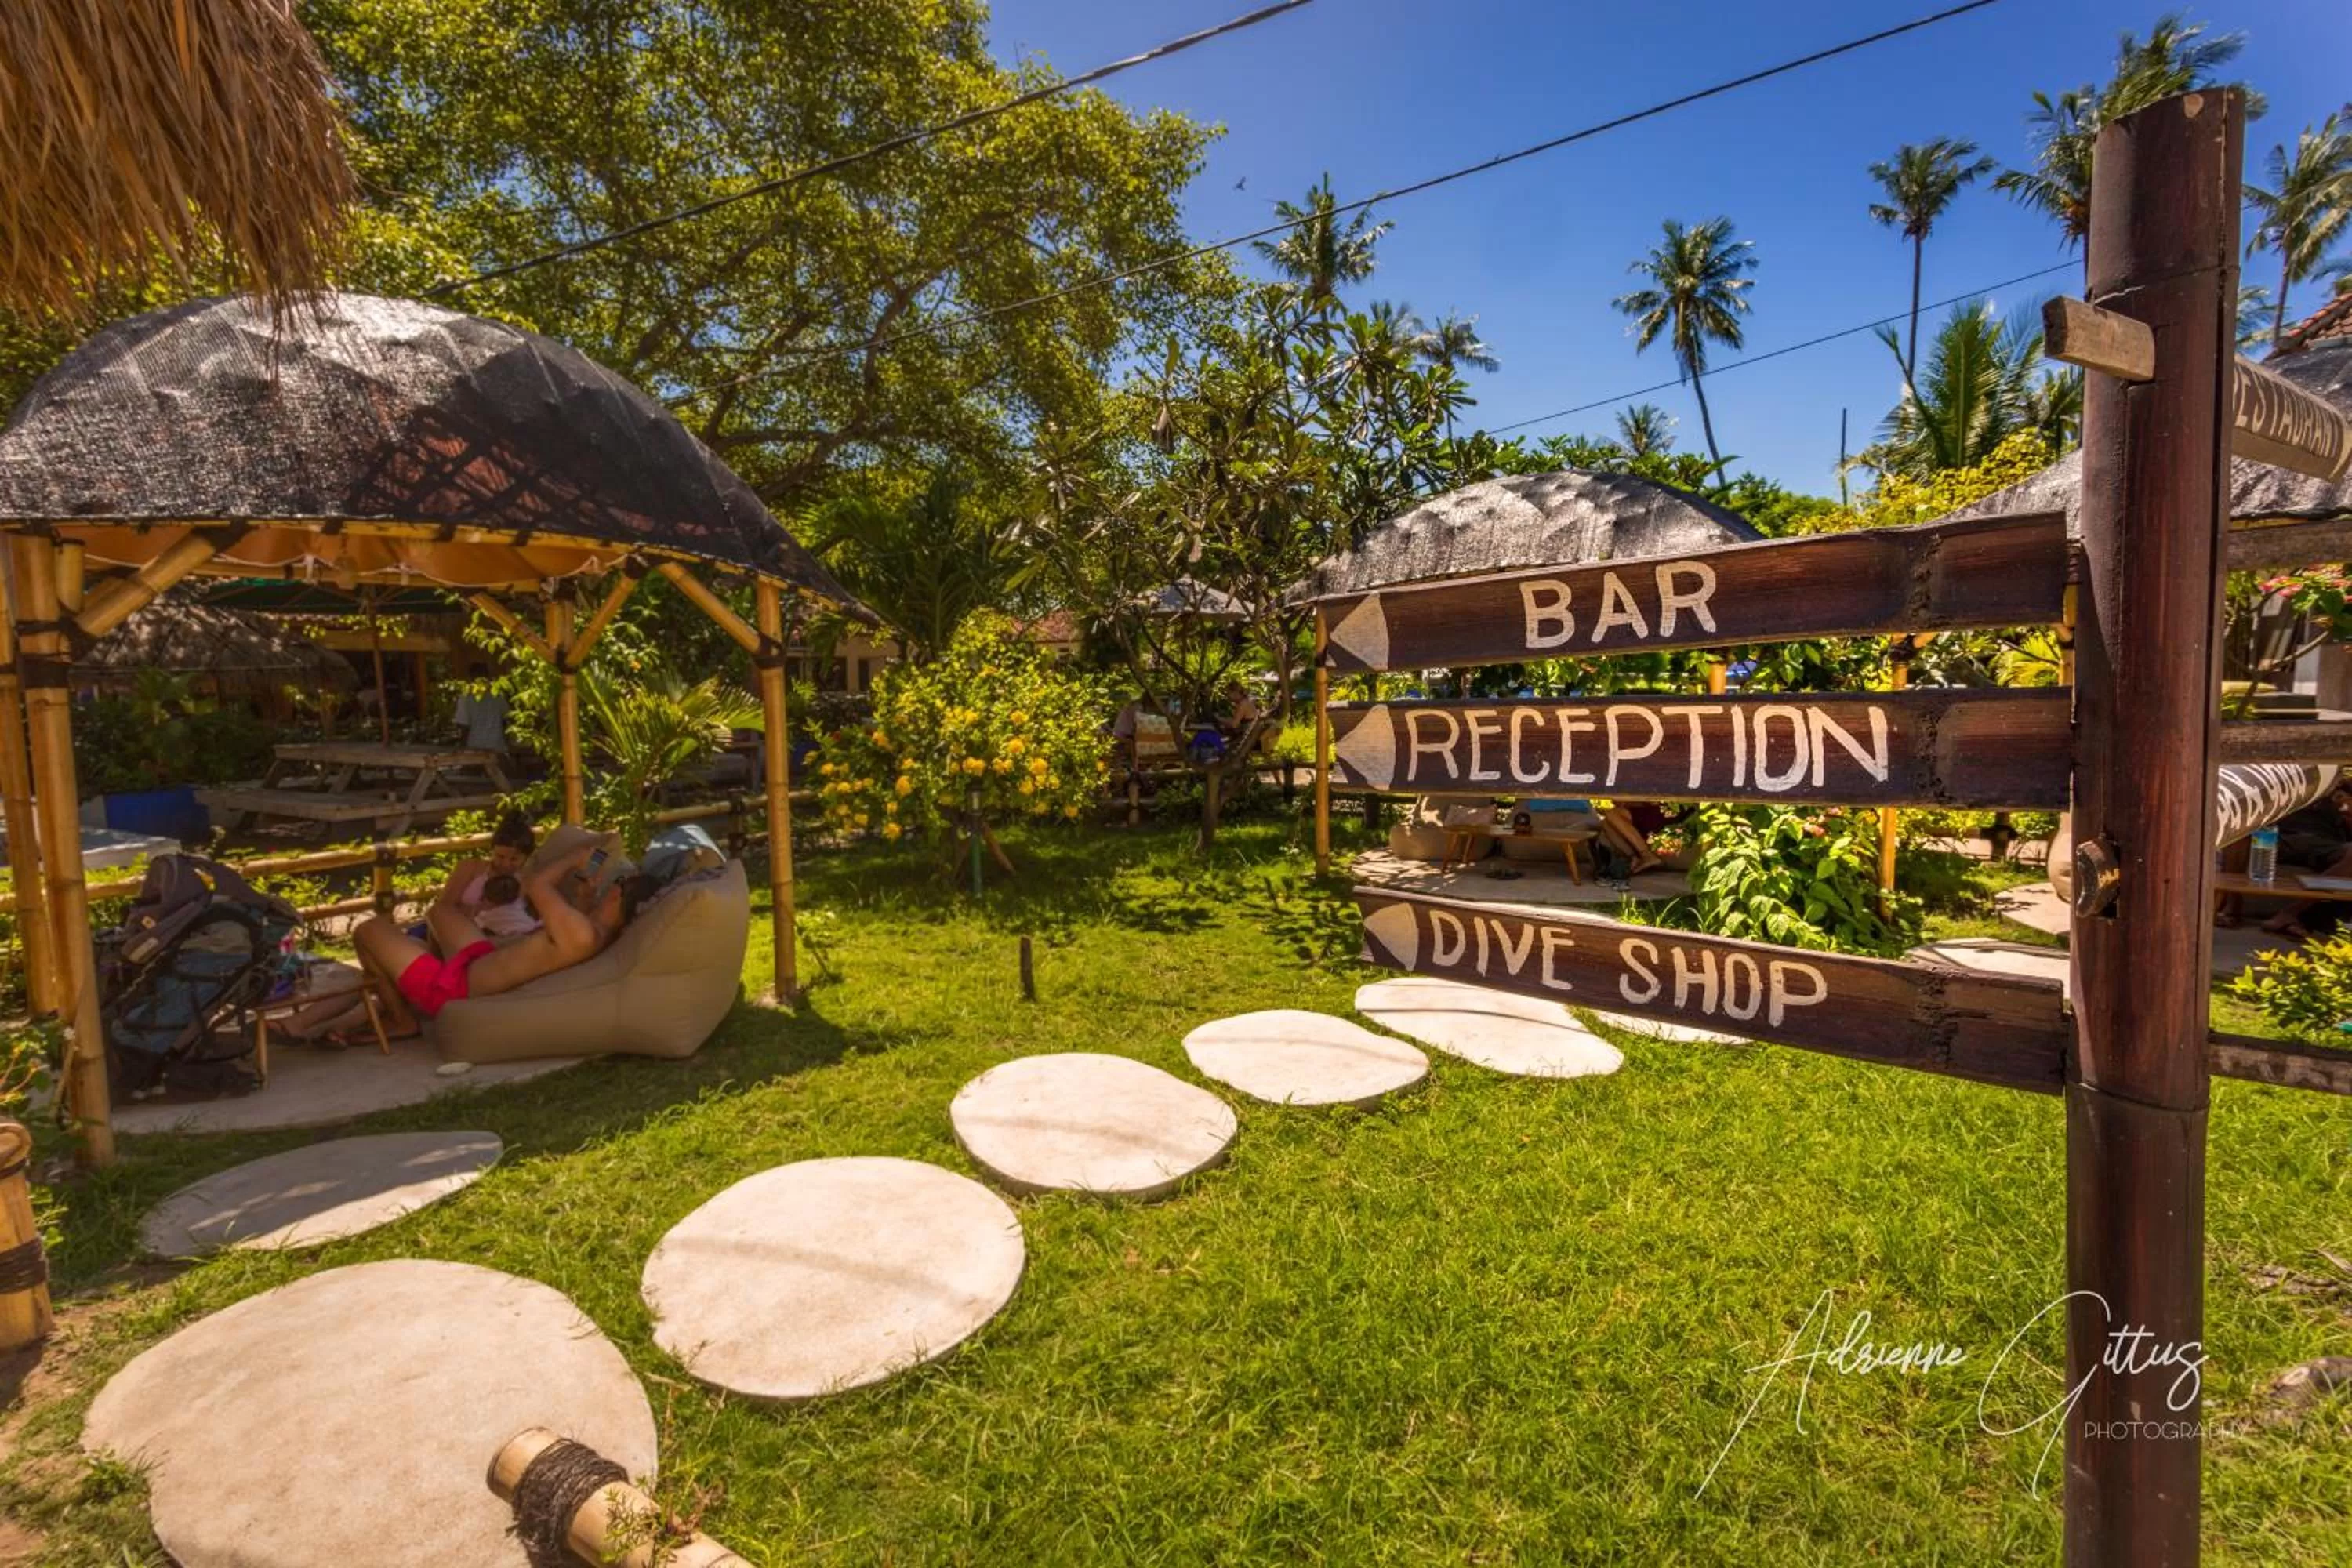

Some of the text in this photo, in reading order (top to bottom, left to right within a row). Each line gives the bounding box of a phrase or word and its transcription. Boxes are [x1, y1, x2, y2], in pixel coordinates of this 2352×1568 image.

[1519, 561, 1718, 649] BAR
[1406, 704, 1889, 792] RECEPTION
[1431, 909, 1828, 1027] DIVE SHOP
